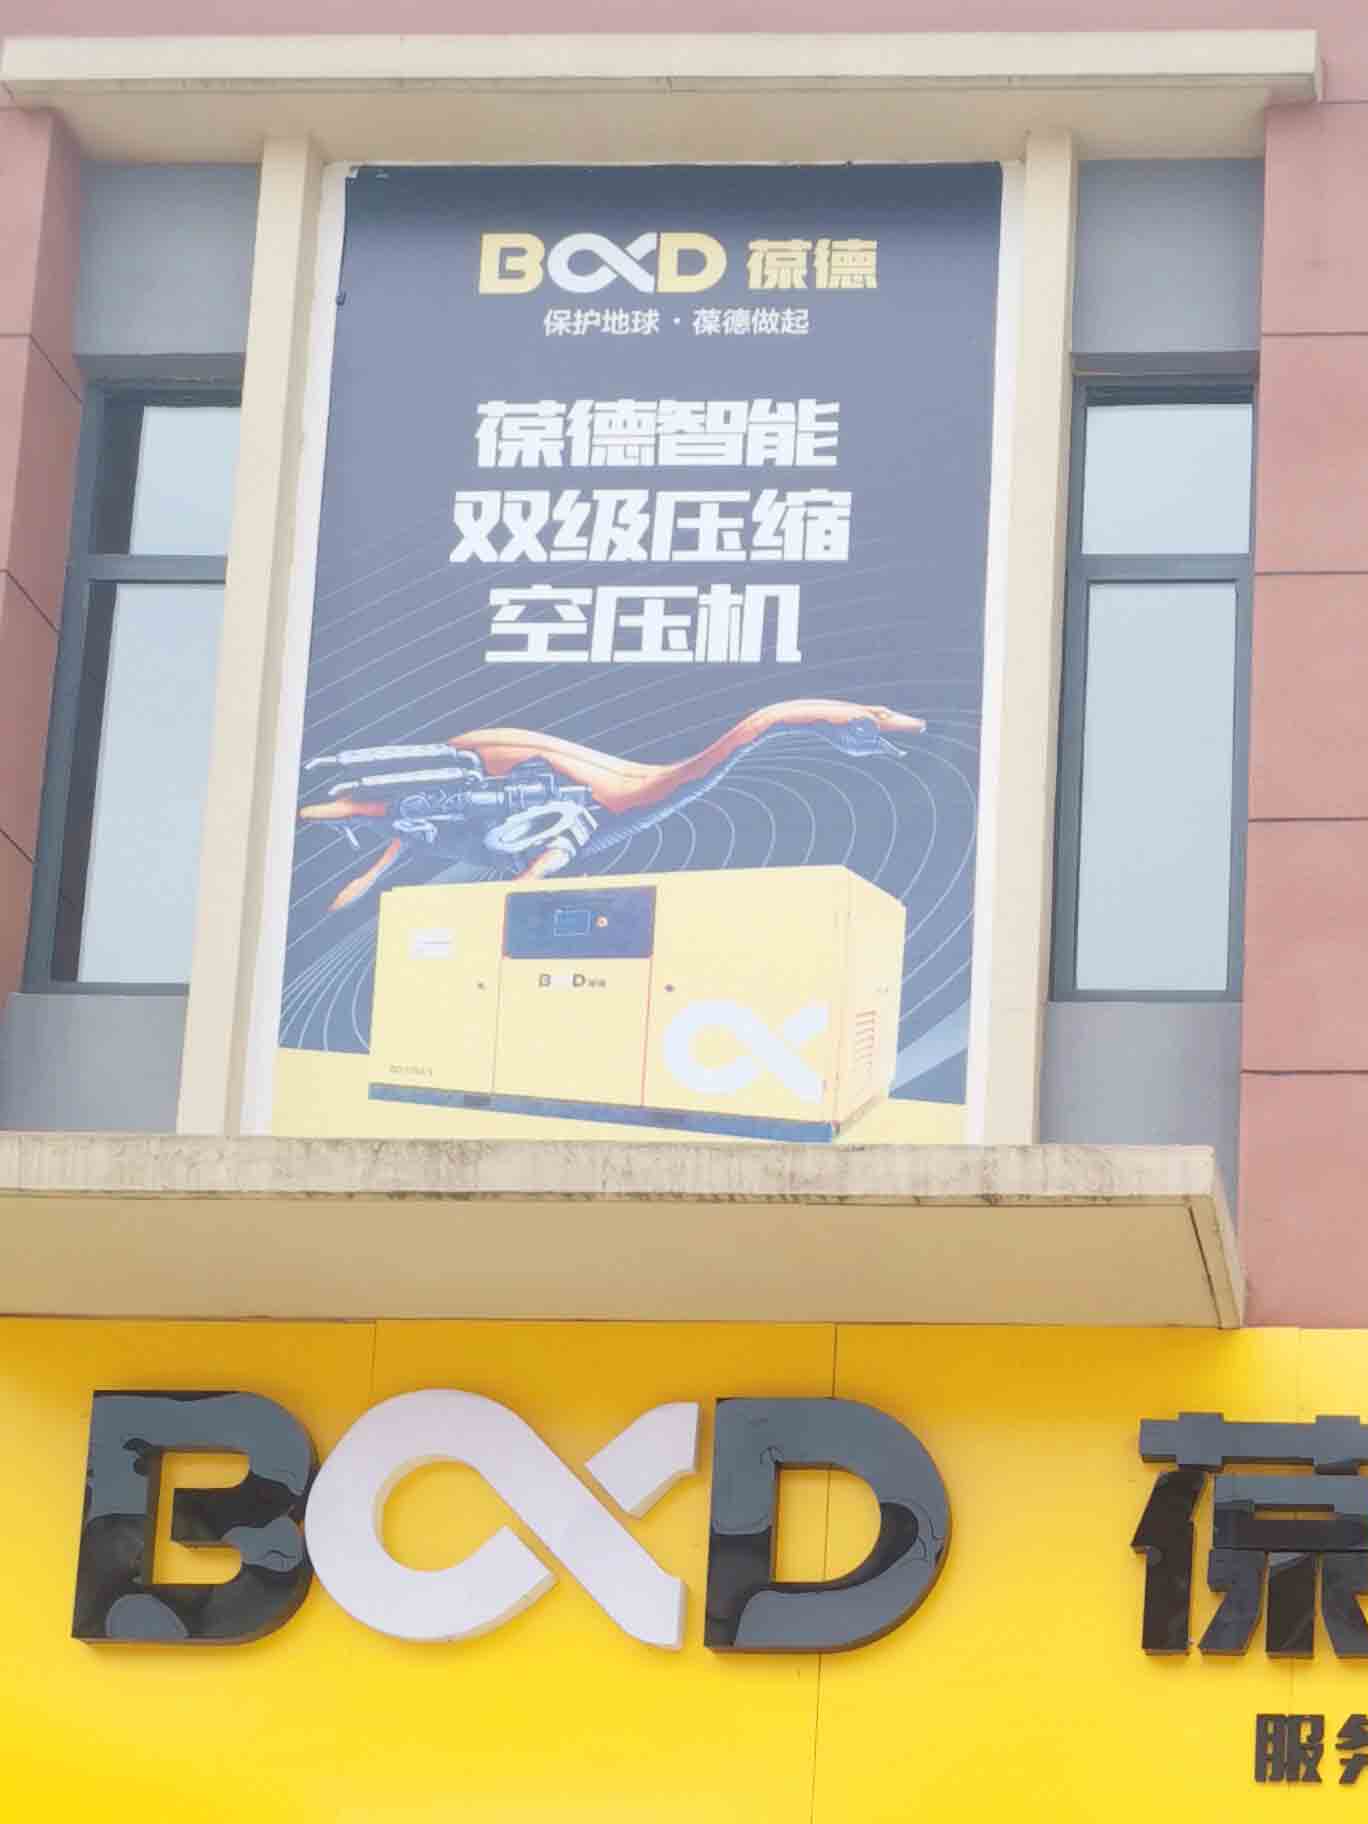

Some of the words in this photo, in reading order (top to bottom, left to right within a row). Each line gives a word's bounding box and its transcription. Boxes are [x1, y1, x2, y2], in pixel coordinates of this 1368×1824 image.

[747, 239, 877, 289] 葆德
[474, 399, 840, 468] 葆德智能
[448, 489, 852, 562] 双级压缩
[484, 584, 802, 662] 空压机
